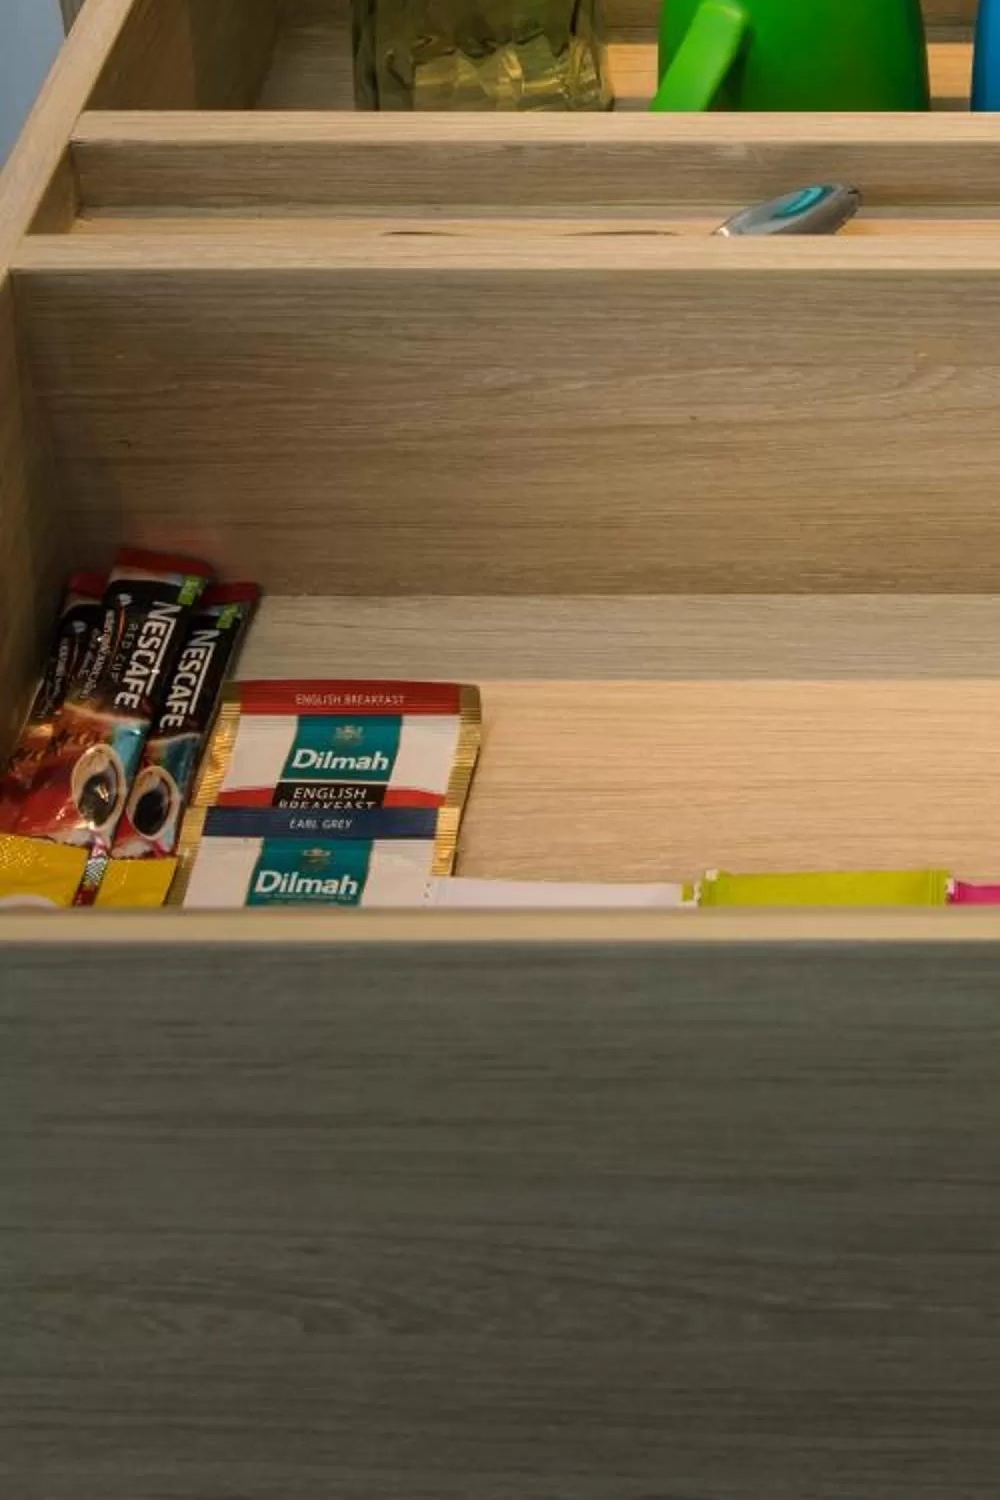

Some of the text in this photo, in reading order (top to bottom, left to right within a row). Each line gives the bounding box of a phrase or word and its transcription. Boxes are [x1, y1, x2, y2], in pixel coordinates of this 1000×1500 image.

[295, 693, 405, 706] ENGLISH BREAKFAST
[291, 748, 389, 772] Dilmah
[293, 786, 368, 800] ENGLISH
[289, 818, 353, 831] EARL GREY
[255, 870, 359, 895] Dilmah
